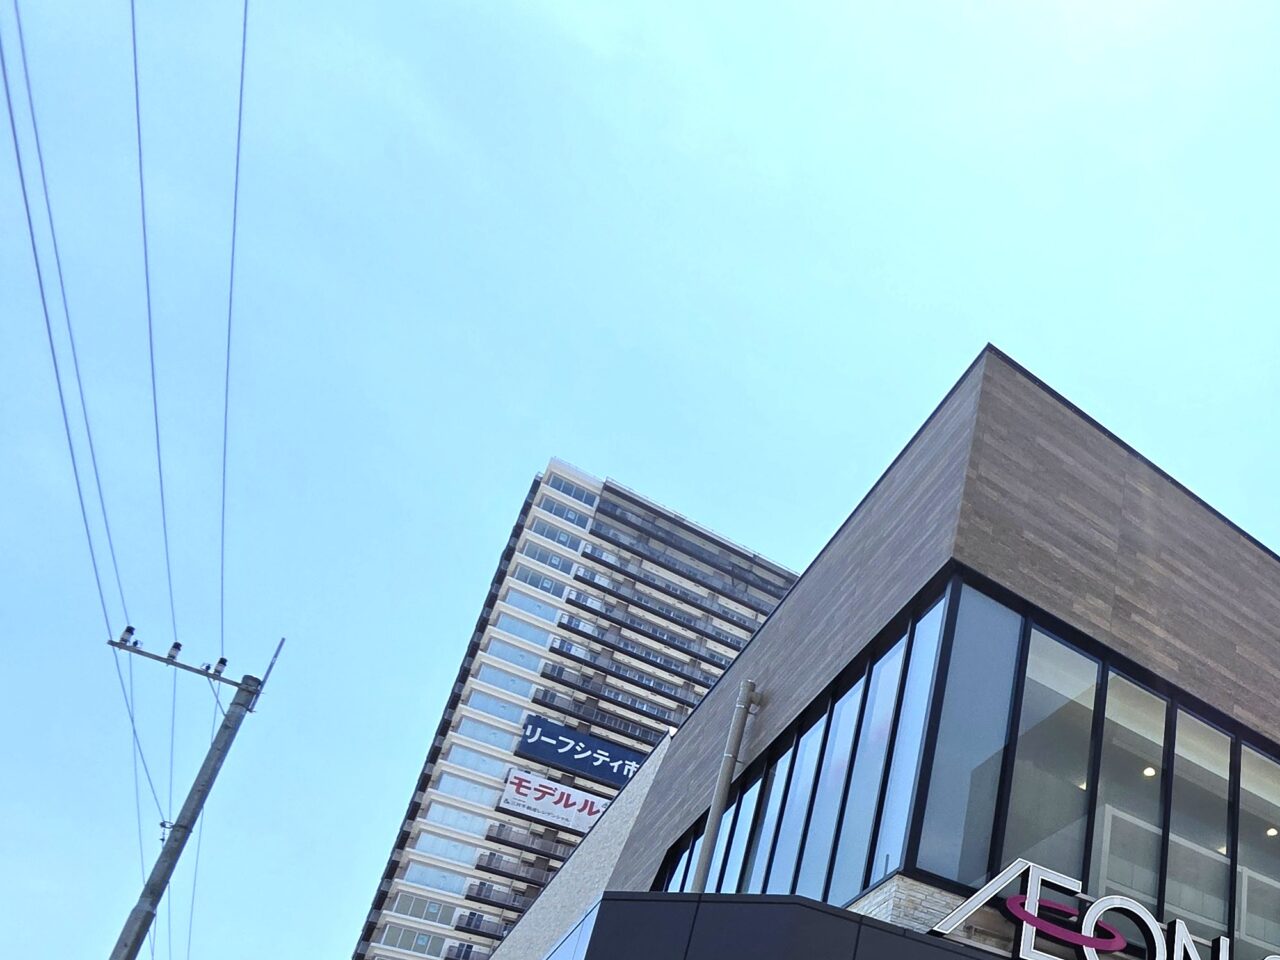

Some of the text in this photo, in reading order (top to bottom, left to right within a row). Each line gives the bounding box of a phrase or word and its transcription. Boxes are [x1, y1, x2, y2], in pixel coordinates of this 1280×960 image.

[525, 724, 640, 778] リーフシティ市
[509, 776, 604, 817] モデルル
